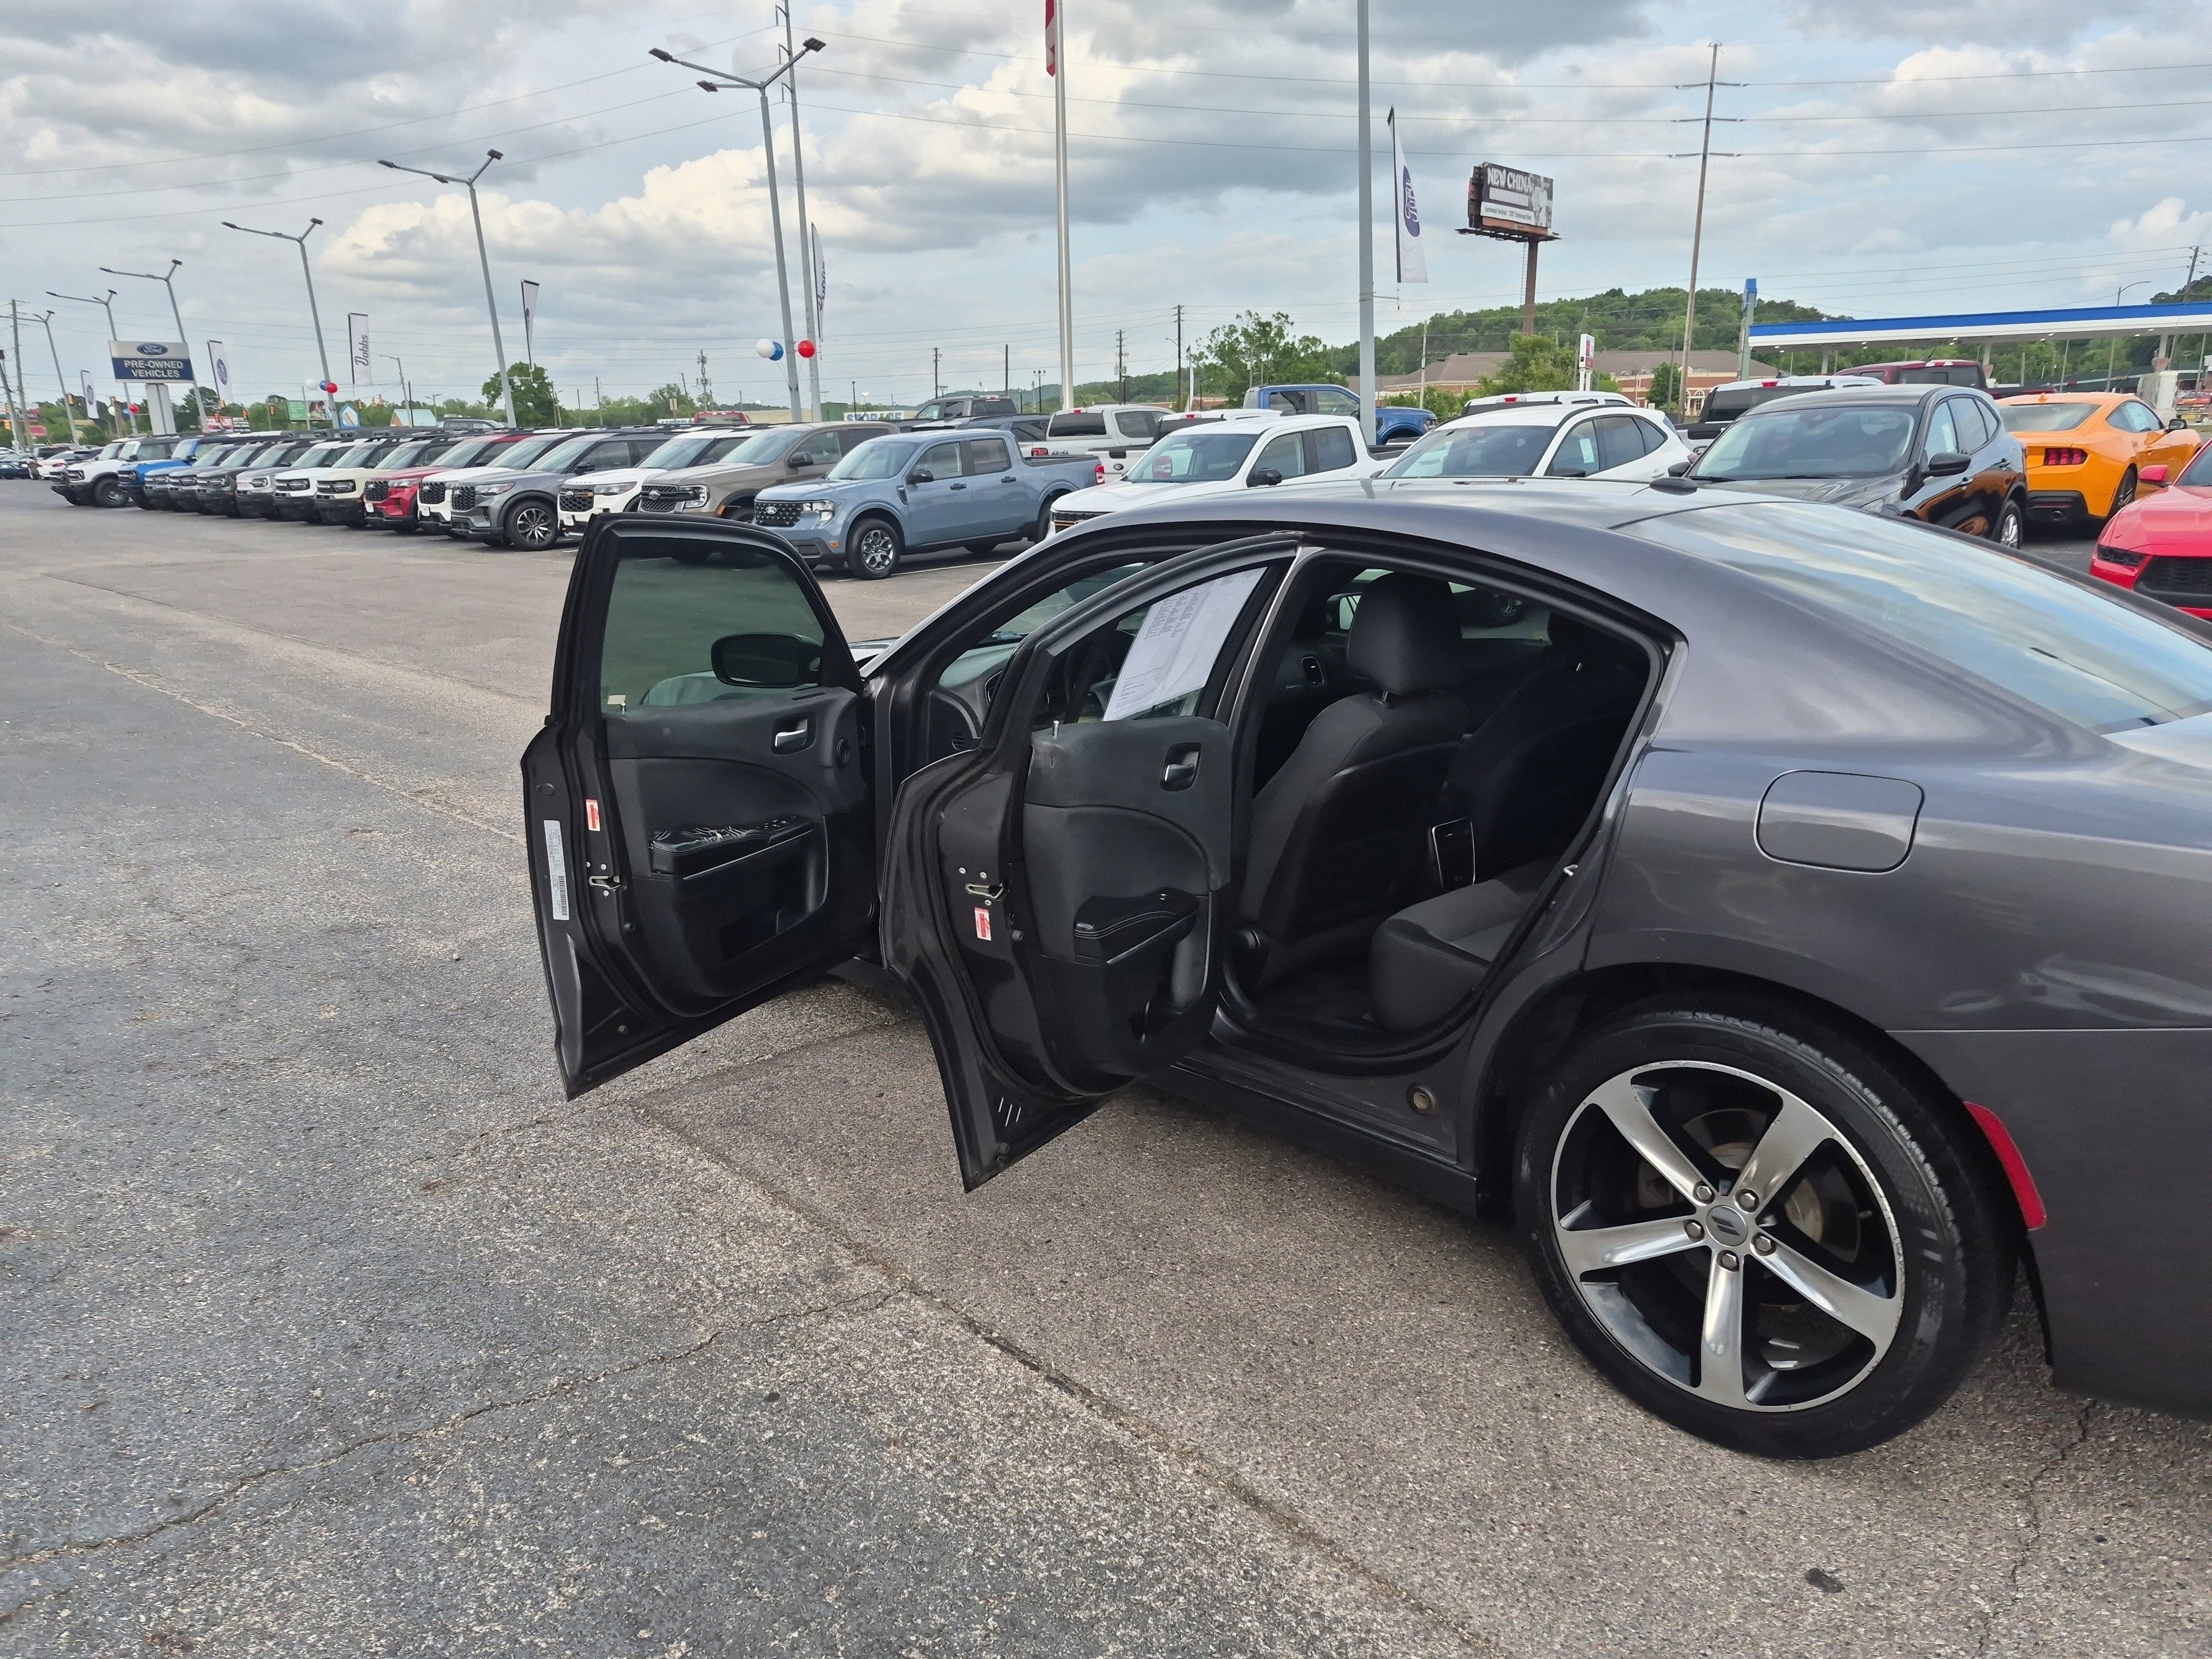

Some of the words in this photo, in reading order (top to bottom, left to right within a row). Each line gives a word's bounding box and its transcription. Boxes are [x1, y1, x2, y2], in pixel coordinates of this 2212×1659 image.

[1487, 166, 1506, 188] NEW
[1507, 171, 1533, 193] CHINA
[354, 333, 369, 366] Dobbs
[124, 359, 183, 369] PRE-OWNED
[131, 369, 180, 378] VEHICLES
[847, 412, 902, 421] STORAGE
